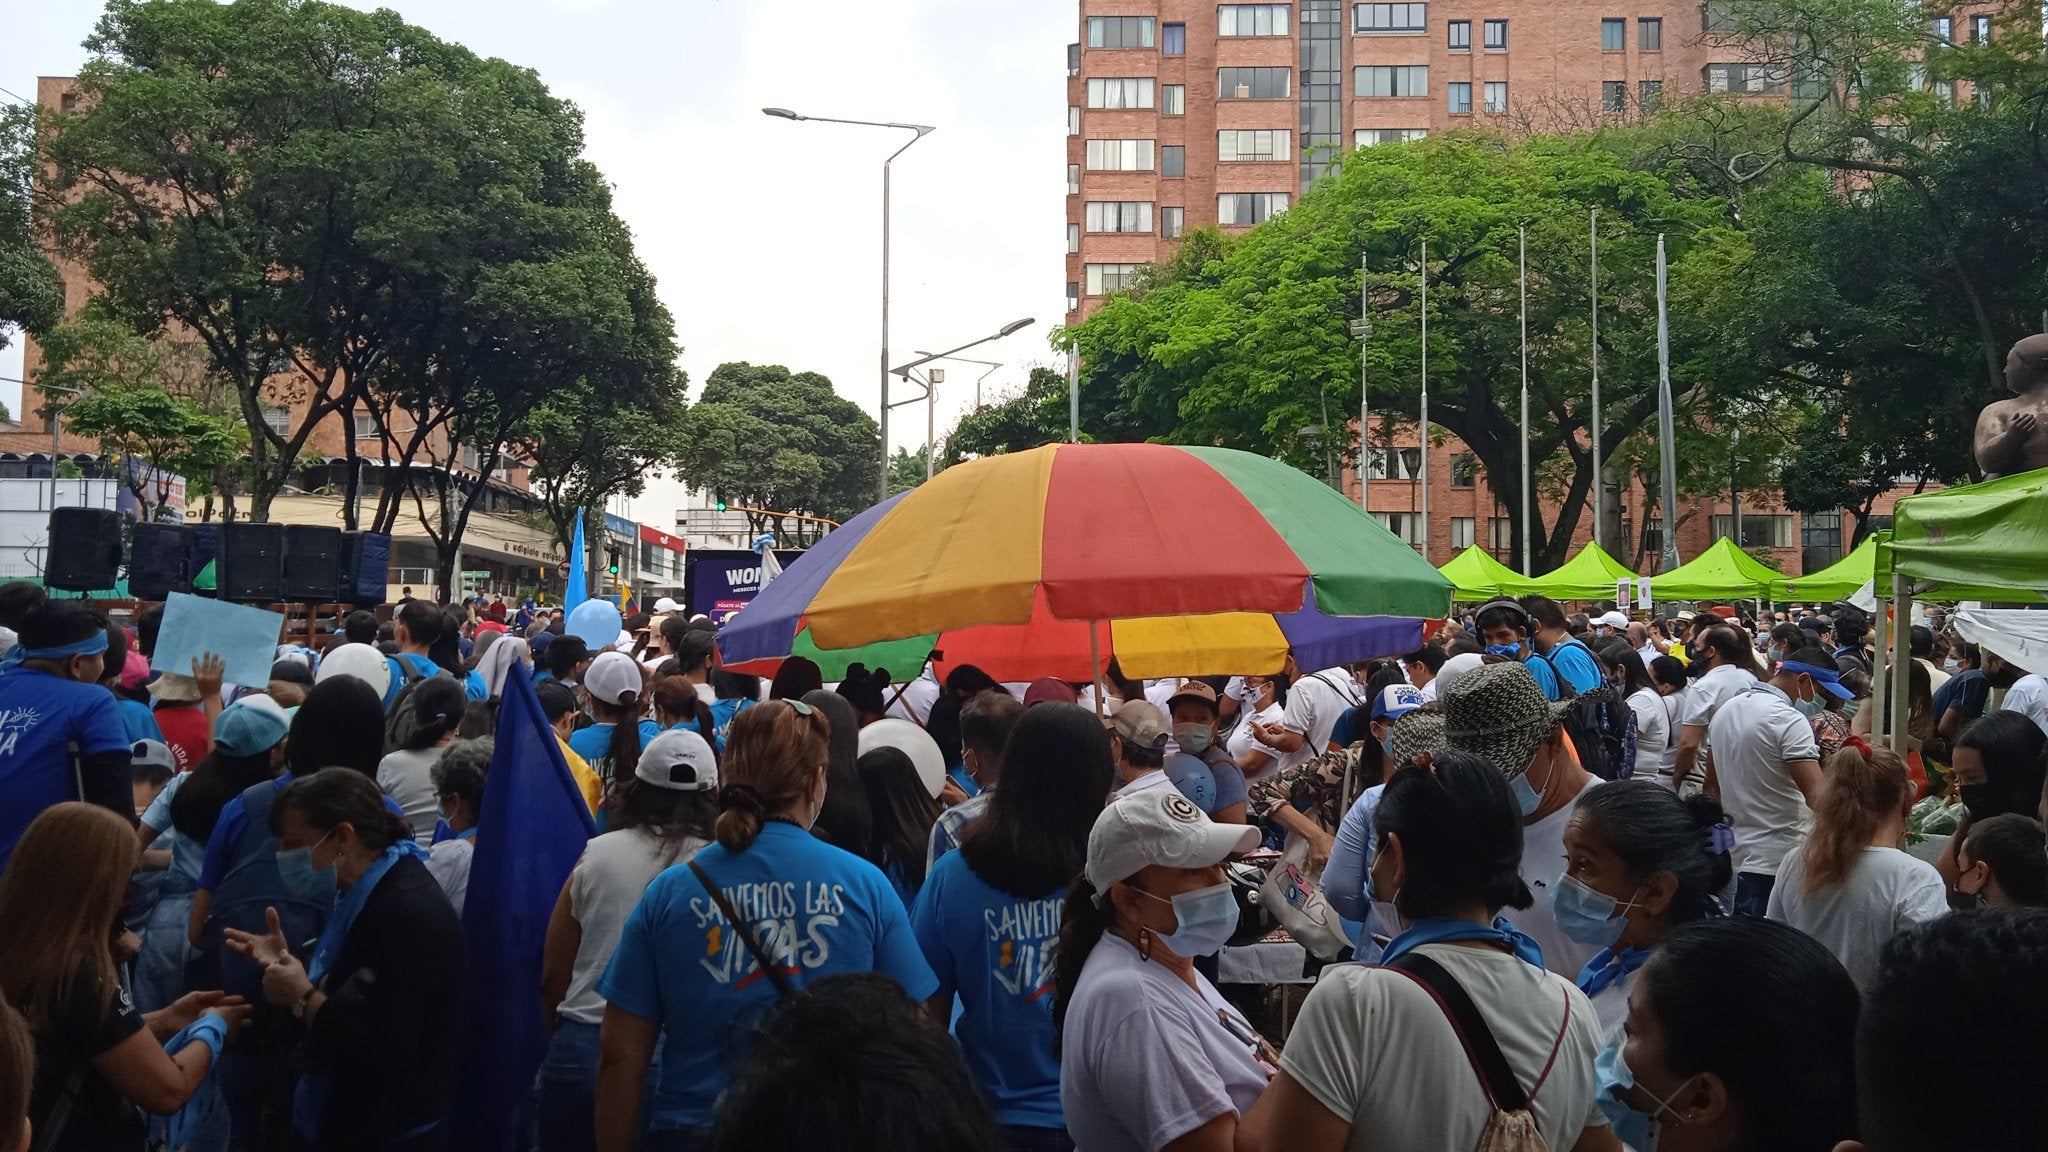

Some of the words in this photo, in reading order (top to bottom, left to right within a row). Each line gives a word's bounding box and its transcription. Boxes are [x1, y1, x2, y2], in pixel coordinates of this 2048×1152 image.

[805, 880, 844, 916] LAS
[984, 898, 1066, 942] SALVEMO
[699, 914, 839, 984] VIDAS
